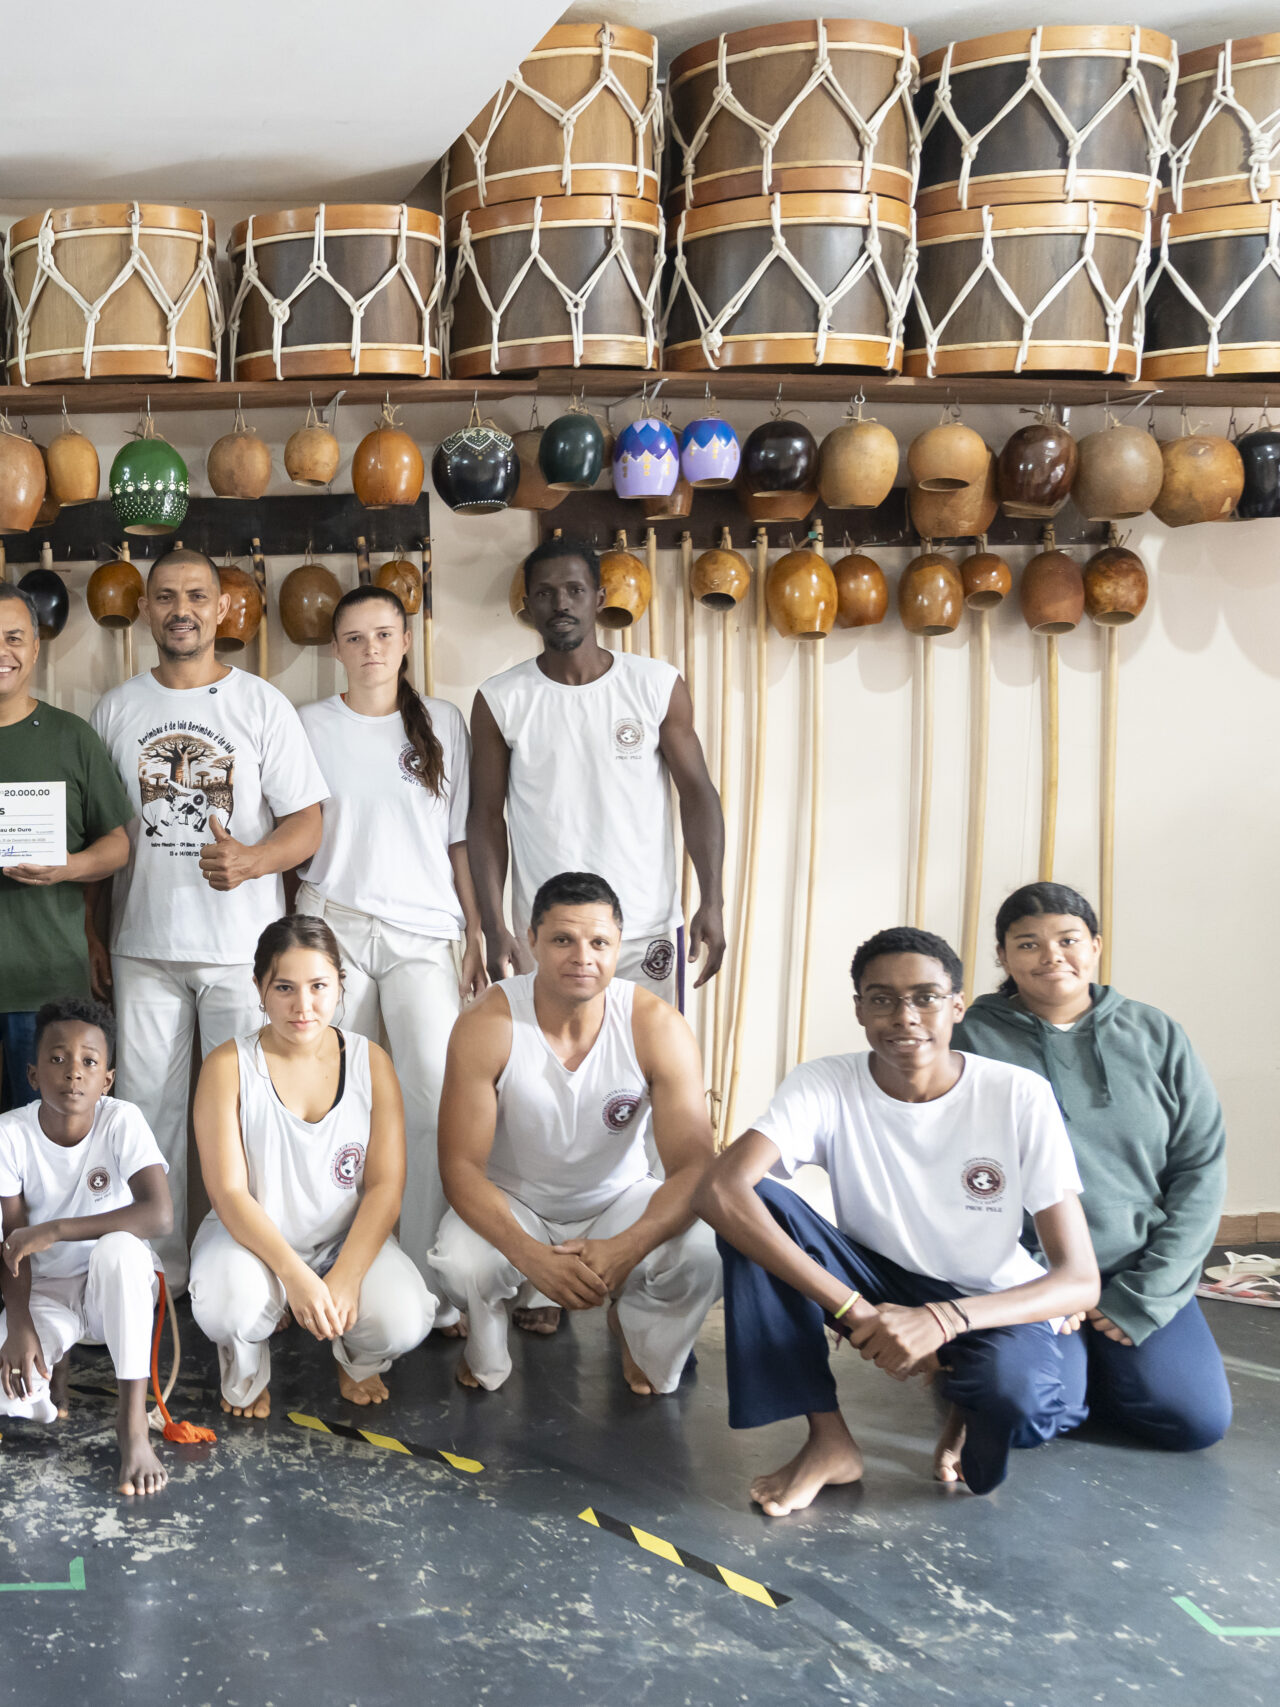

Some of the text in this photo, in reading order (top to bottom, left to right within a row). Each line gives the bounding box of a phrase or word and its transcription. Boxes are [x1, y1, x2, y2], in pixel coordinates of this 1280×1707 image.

[169, 721, 176, 730] de
[187, 721, 214, 738] Berimbau
[4, 789, 50, 797] 20.000,00
